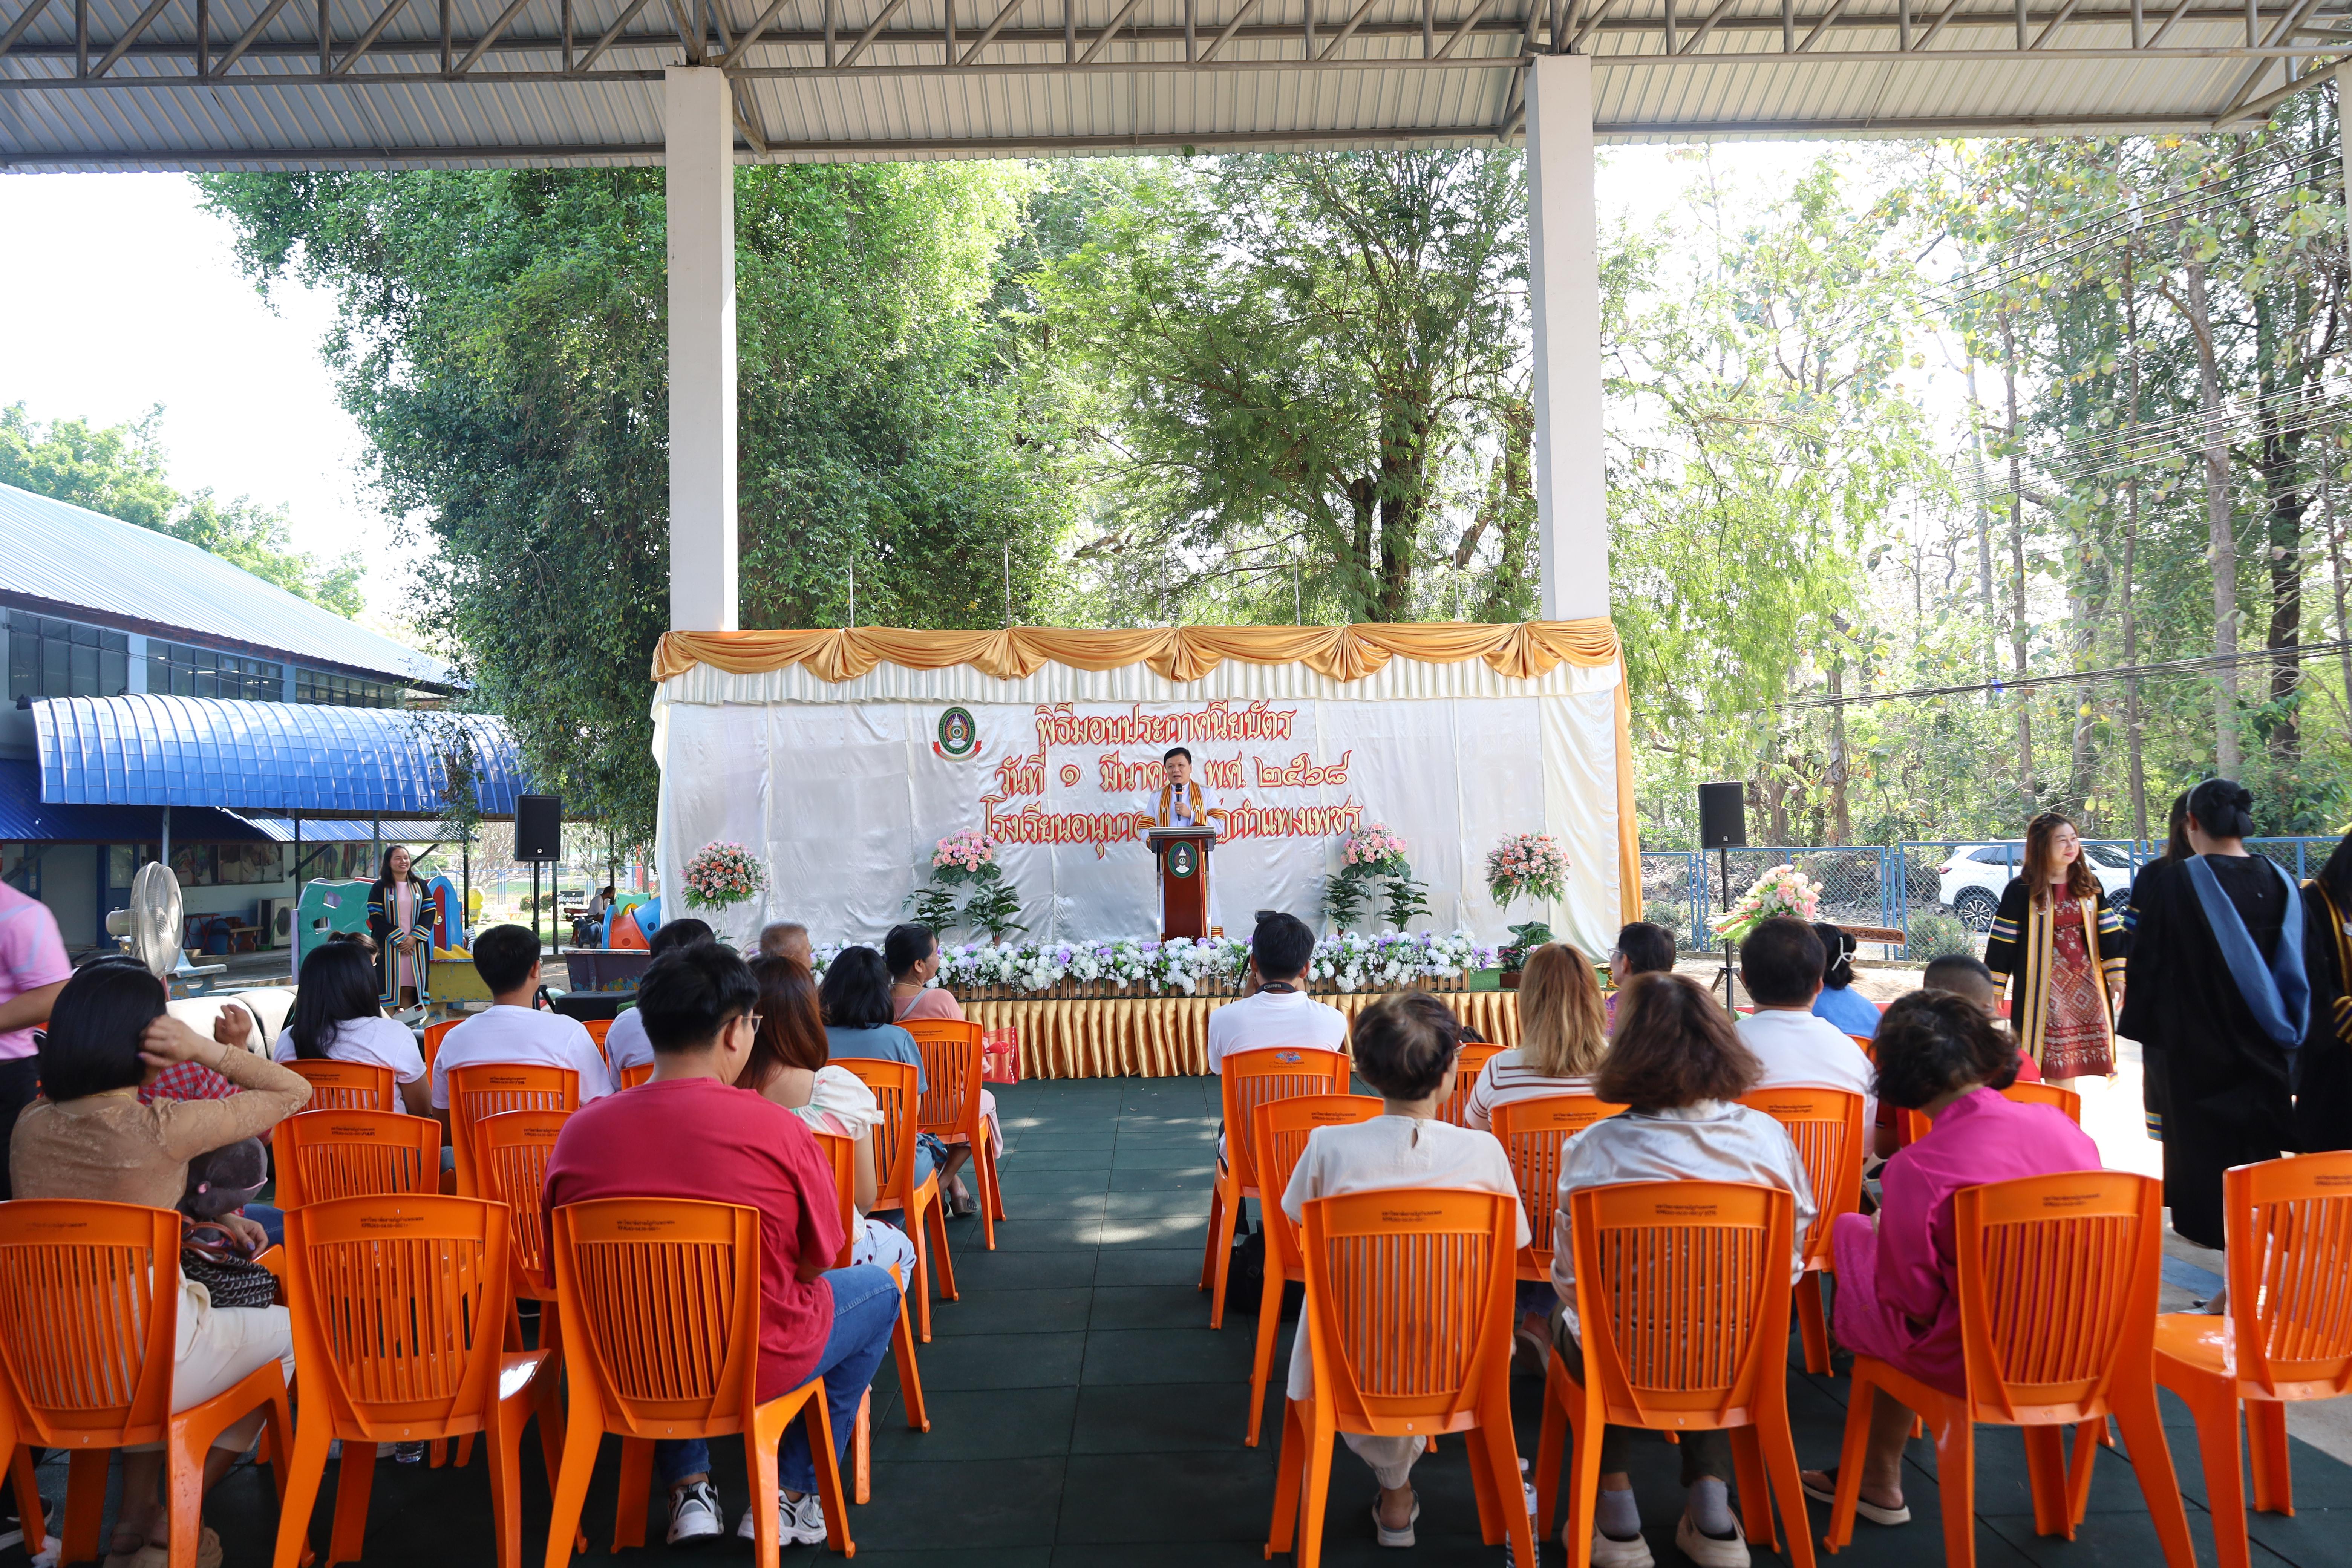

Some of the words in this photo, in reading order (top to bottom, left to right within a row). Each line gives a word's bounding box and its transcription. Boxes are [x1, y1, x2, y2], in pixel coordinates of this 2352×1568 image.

[1035, 700, 1297, 745] พิธีมอบประกาศนียบัตร
[995, 745, 1046, 796] วันที่
[1060, 764, 1080, 786] ๑
[1205, 749, 1247, 790] พ.ศ.
[1253, 750, 1352, 788] ๒๕๖๘
